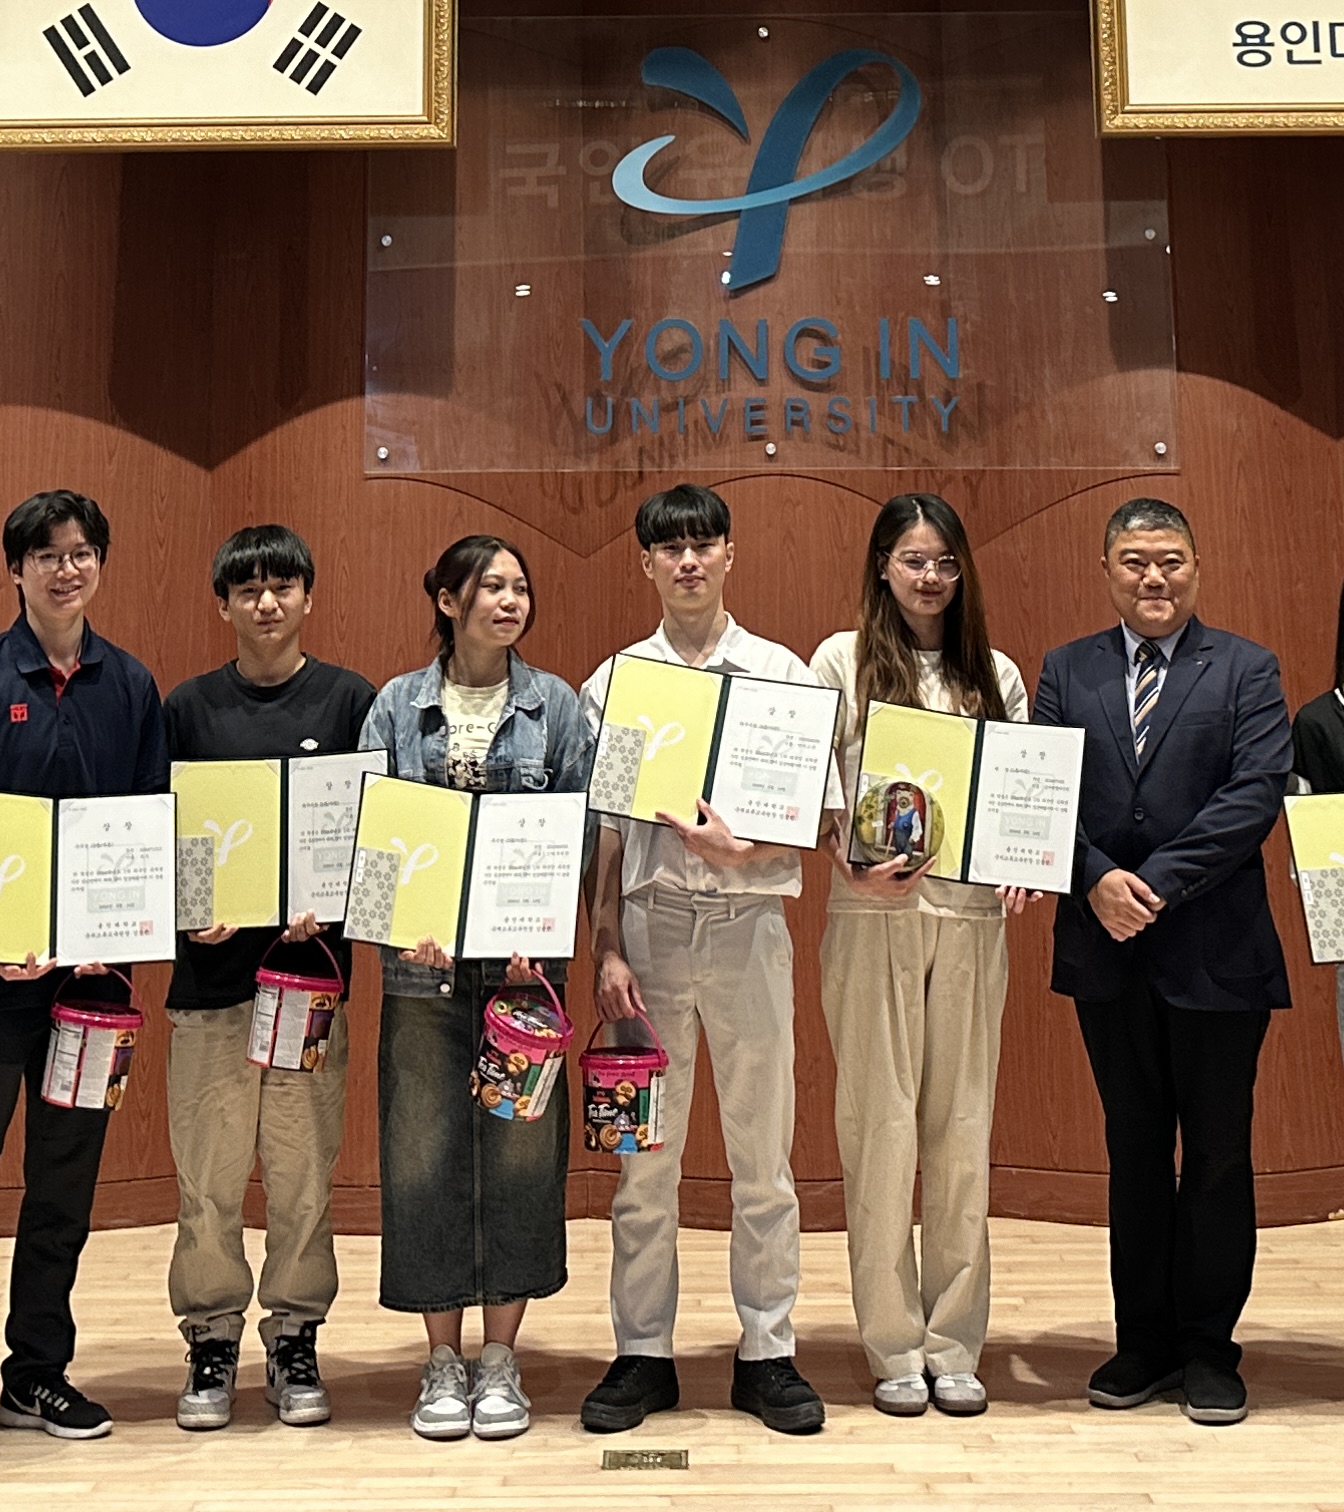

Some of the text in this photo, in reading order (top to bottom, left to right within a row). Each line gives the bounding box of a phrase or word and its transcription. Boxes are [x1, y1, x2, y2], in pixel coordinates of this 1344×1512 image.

[580, 316, 960, 381] YONG IN
[585, 395, 961, 435] UNIVERSITY
